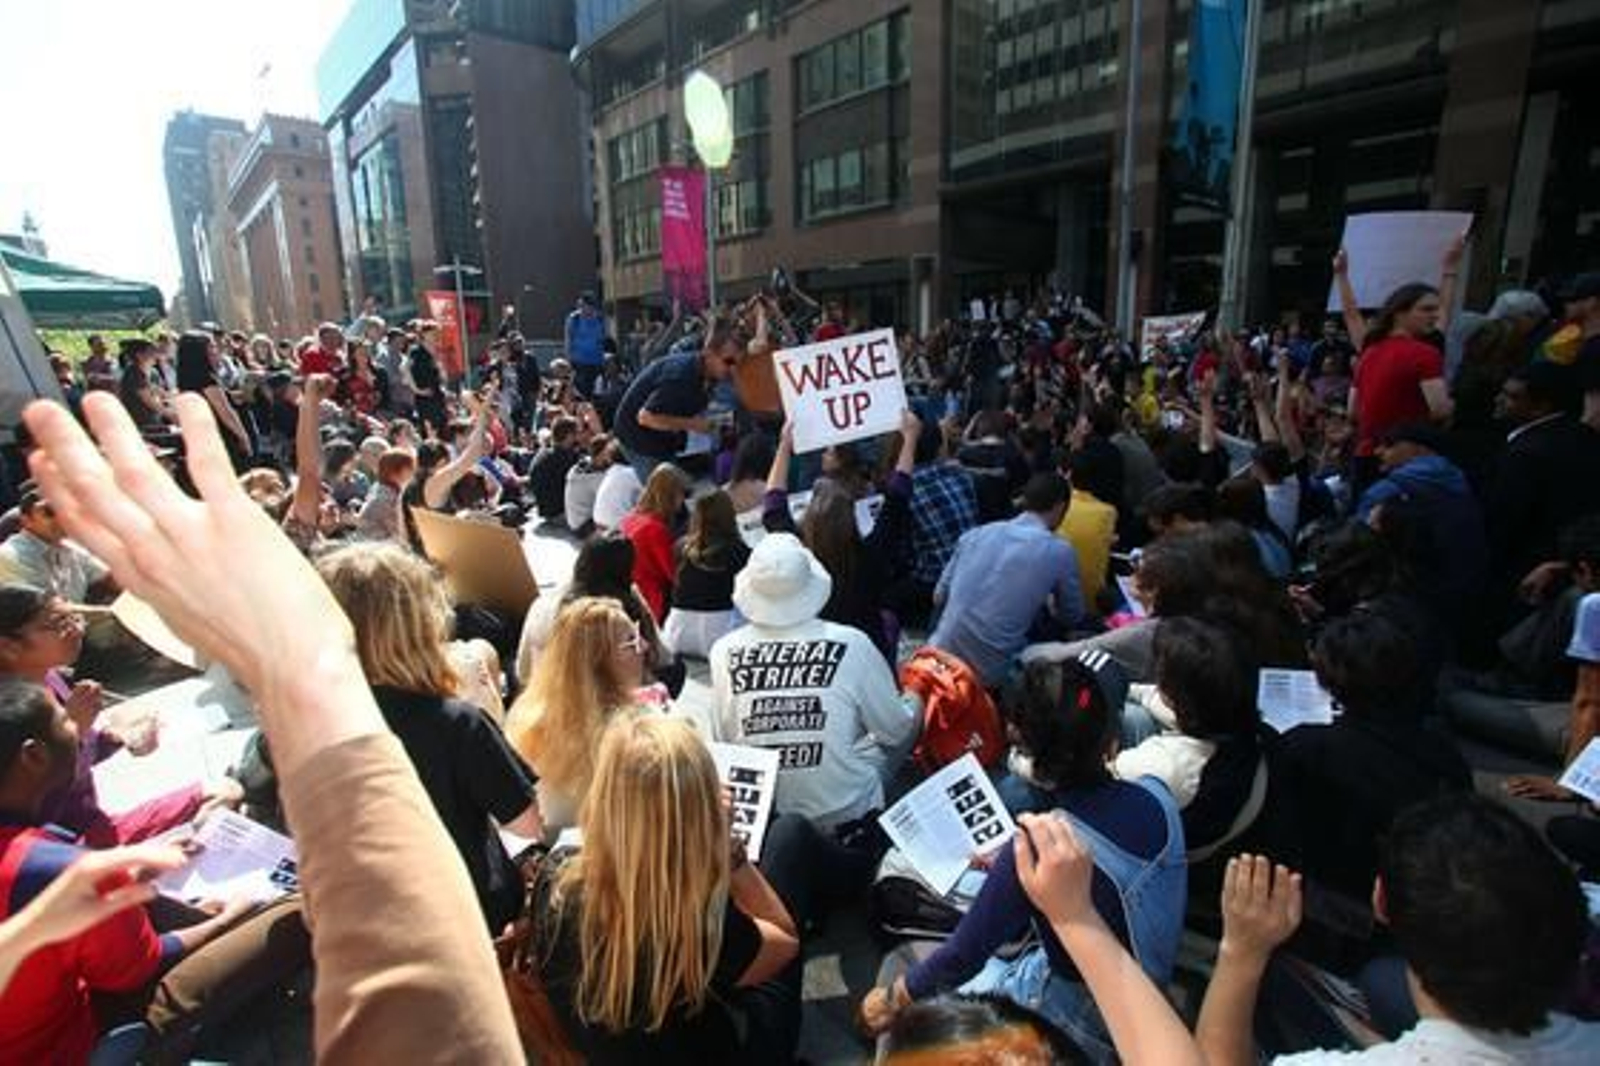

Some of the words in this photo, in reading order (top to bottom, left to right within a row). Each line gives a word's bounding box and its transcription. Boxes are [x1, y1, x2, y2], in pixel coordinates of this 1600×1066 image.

[780, 338, 896, 396] WAKE
[822, 391, 871, 431] UP
[729, 641, 840, 669] GENERAL
[735, 664, 833, 691] STRIKE!
[755, 698, 816, 714] AGAINST
[744, 712, 823, 732] CORPORATE
